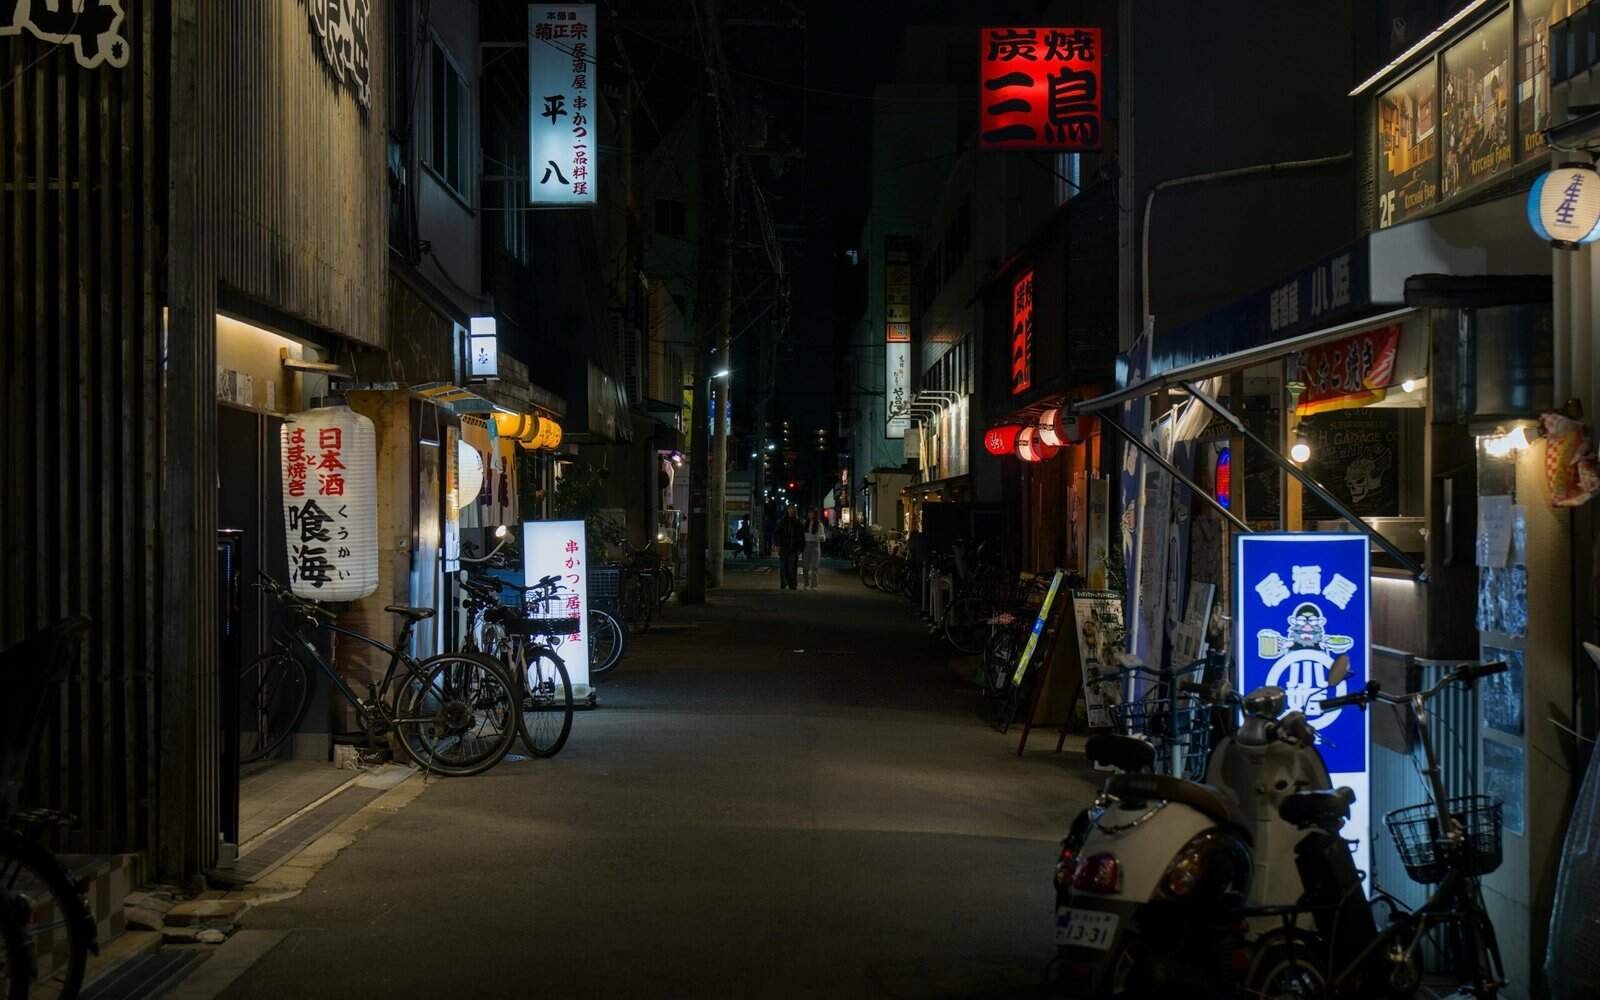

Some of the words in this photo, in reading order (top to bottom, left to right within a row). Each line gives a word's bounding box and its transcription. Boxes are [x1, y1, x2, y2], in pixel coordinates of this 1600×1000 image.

[535, 22, 588, 40] 菊正宗
[987, 29, 1095, 61] 炭焼
[540, 94, 570, 185] 平八
[1379, 190, 1396, 229] 2F
[287, 427, 306, 497] はま焼き
[306, 455, 317, 466] と
[316, 427, 346, 496] 日本酒
[288, 498, 336, 589] 喰海
[337, 504, 350, 581] くうかい
